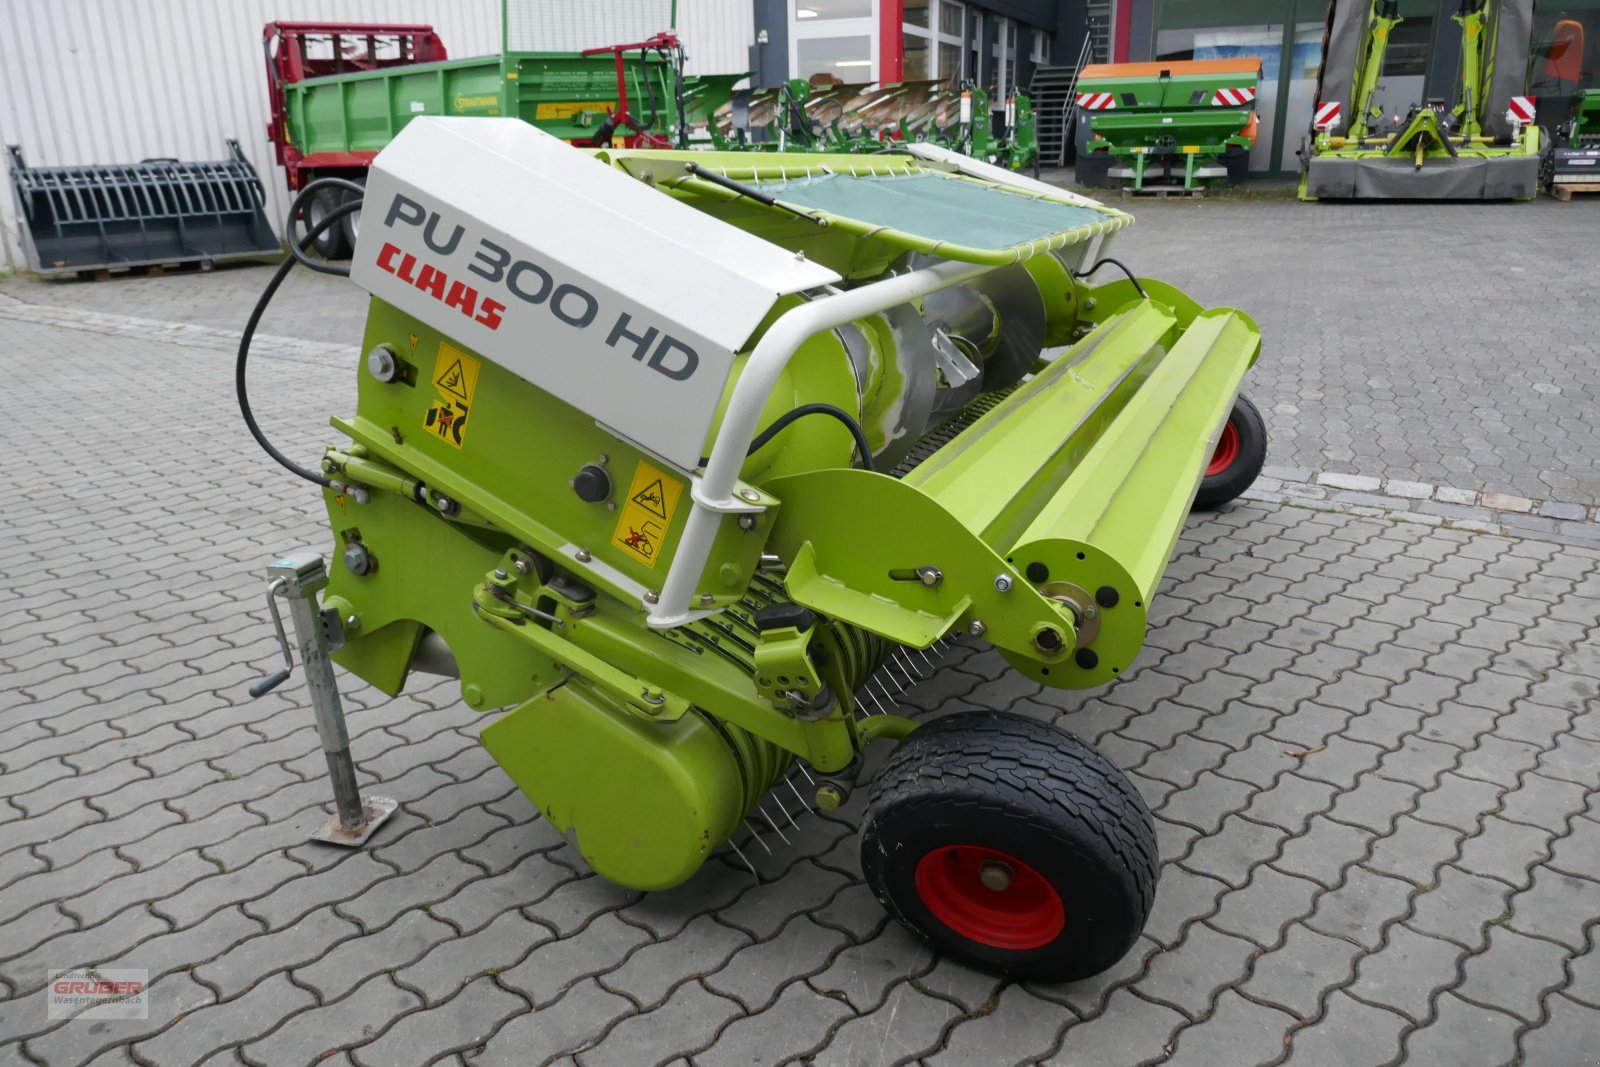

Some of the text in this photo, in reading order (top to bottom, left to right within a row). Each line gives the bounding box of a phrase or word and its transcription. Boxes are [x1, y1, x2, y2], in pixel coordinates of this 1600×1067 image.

[376, 242, 506, 331] CLAAS
[384, 193, 700, 382] PU 300 HD
